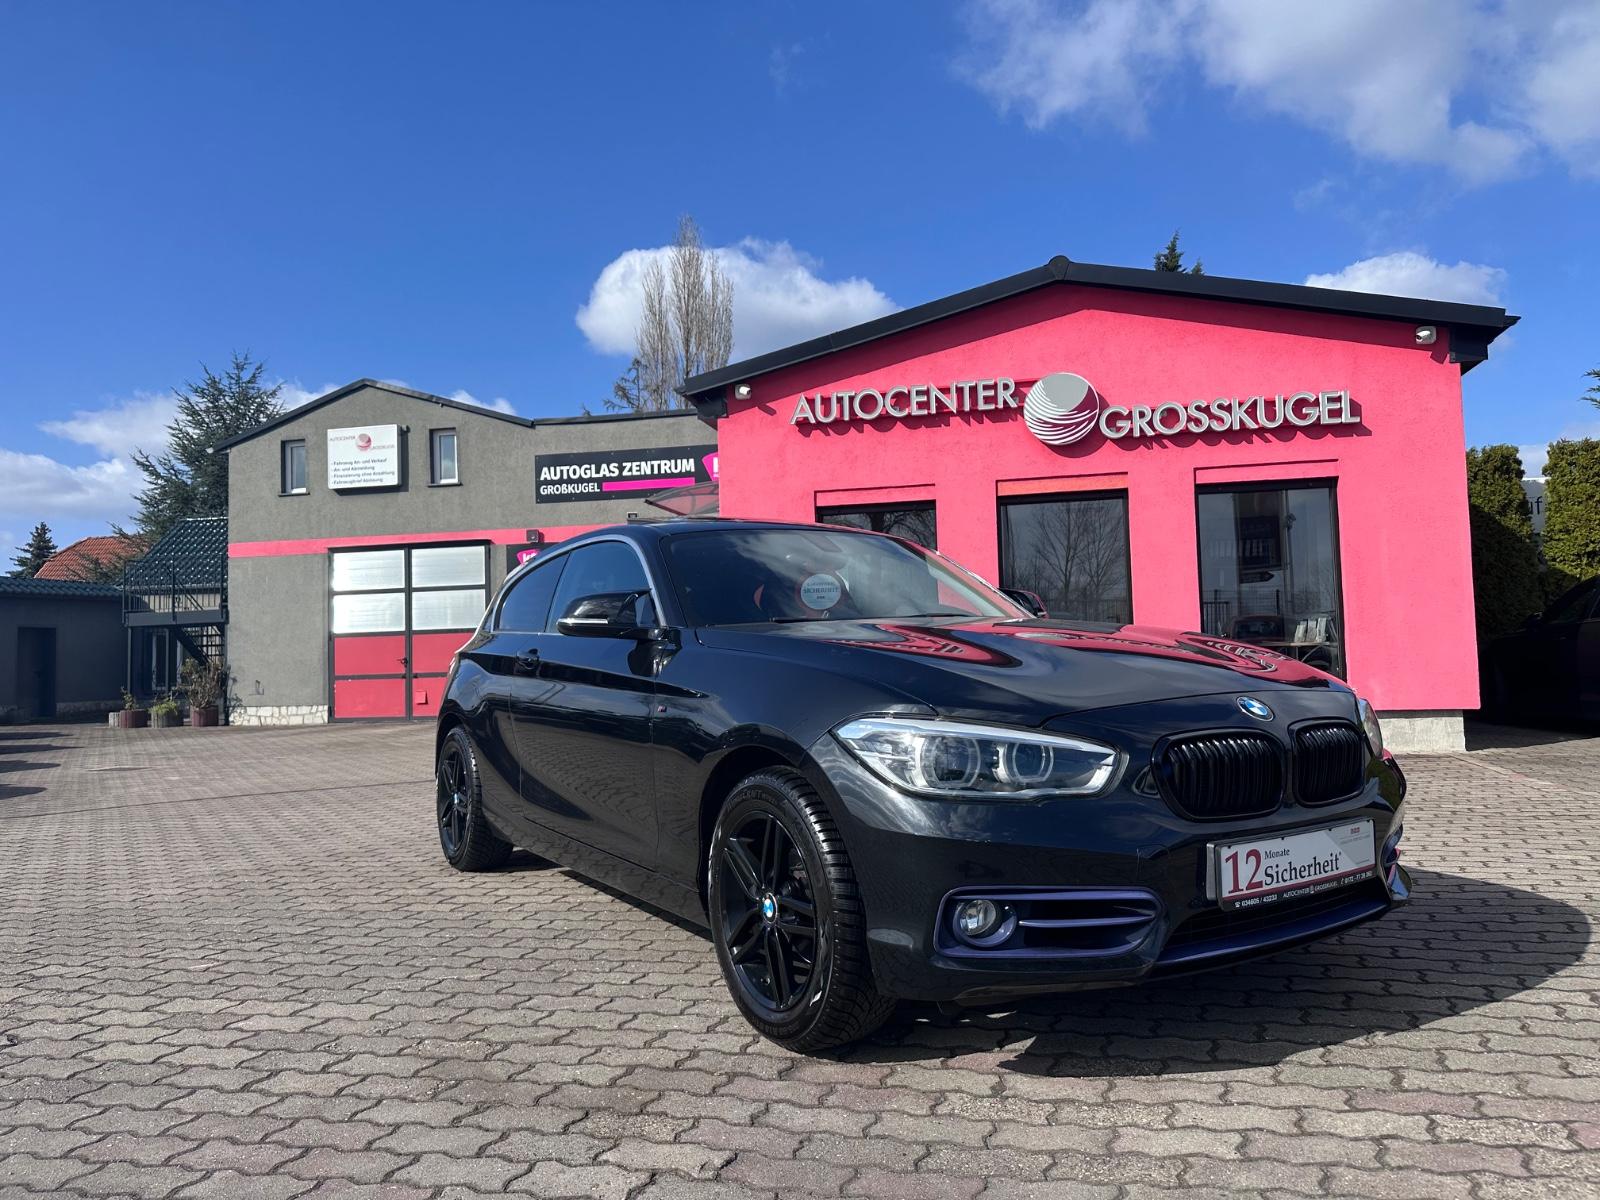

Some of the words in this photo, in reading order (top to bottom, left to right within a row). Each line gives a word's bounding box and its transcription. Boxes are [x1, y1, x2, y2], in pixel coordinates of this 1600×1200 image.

[790, 377, 1018, 425] AUTOCENTER
[1099, 390, 1361, 439] GROSSKUGEL
[540, 463, 619, 481] AUTOGLAS
[622, 458, 695, 477] ZENTRUM
[540, 482, 600, 495] GROßKUGEL
[1264, 848, 1290, 860] Monate
[1225, 848, 1263, 894] 12
